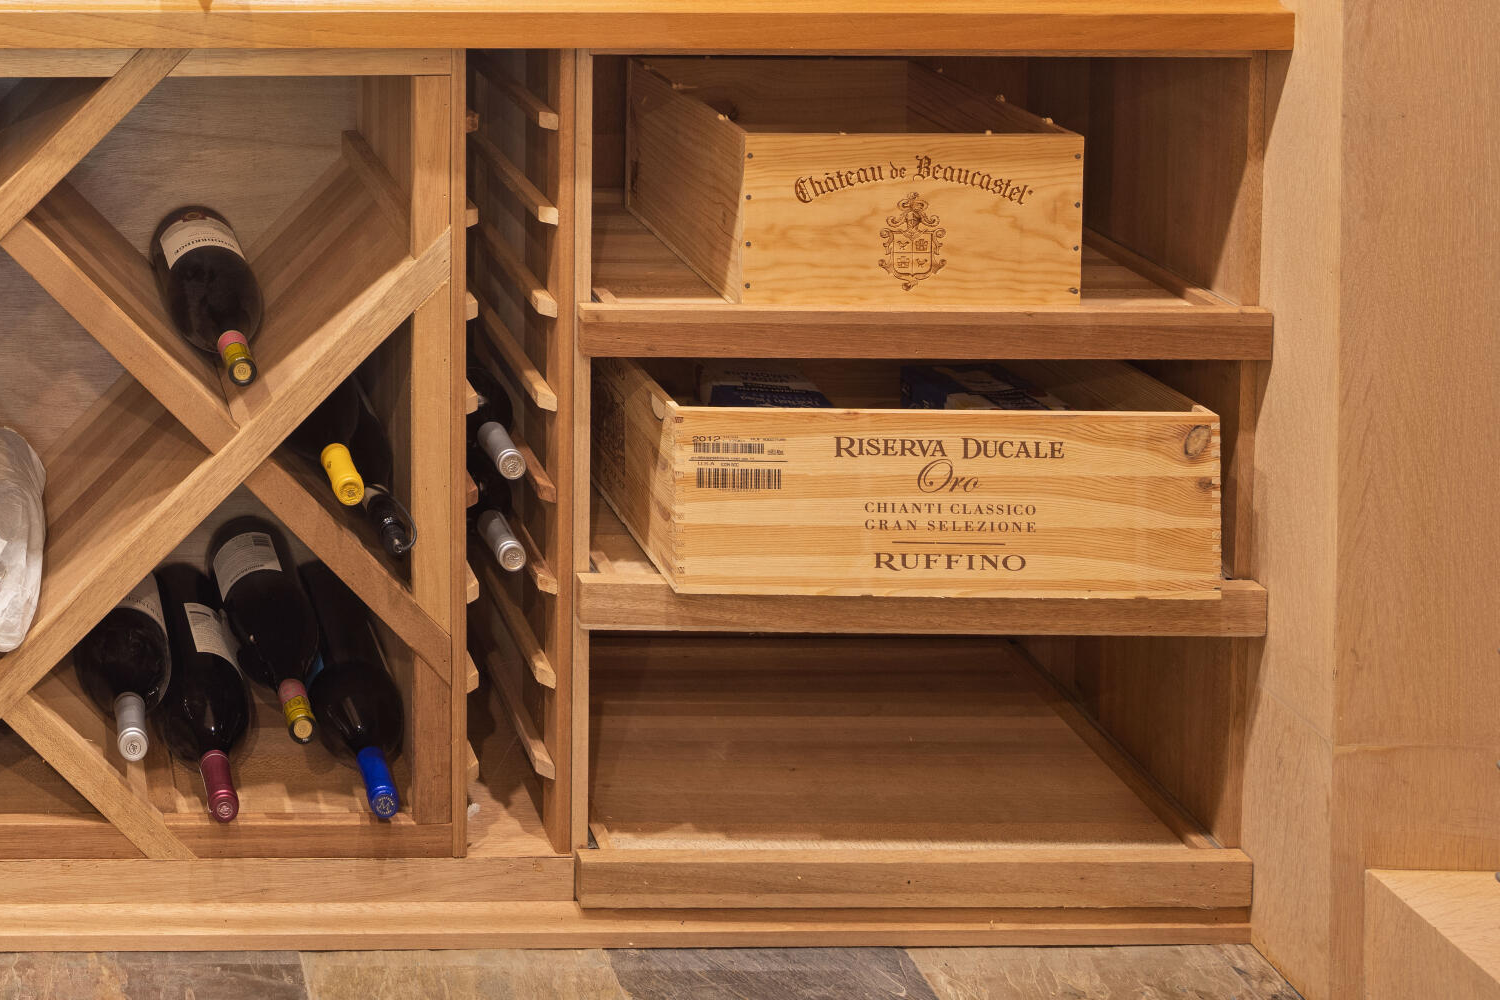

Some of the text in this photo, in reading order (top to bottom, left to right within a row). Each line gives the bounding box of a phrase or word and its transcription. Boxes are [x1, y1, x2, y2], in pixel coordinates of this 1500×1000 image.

[794, 154, 1027, 206] Château de Beaucastel
[692, 435, 721, 443] 2012
[834, 436, 1065, 460] RISERVA DUCALE
[917, 458, 983, 494] Oro
[864, 502, 1037, 517] CHIANTI CLASSICO
[864, 519, 1037, 534] GRAN SELEZIONE
[874, 552, 1027, 573] RUFFINO
